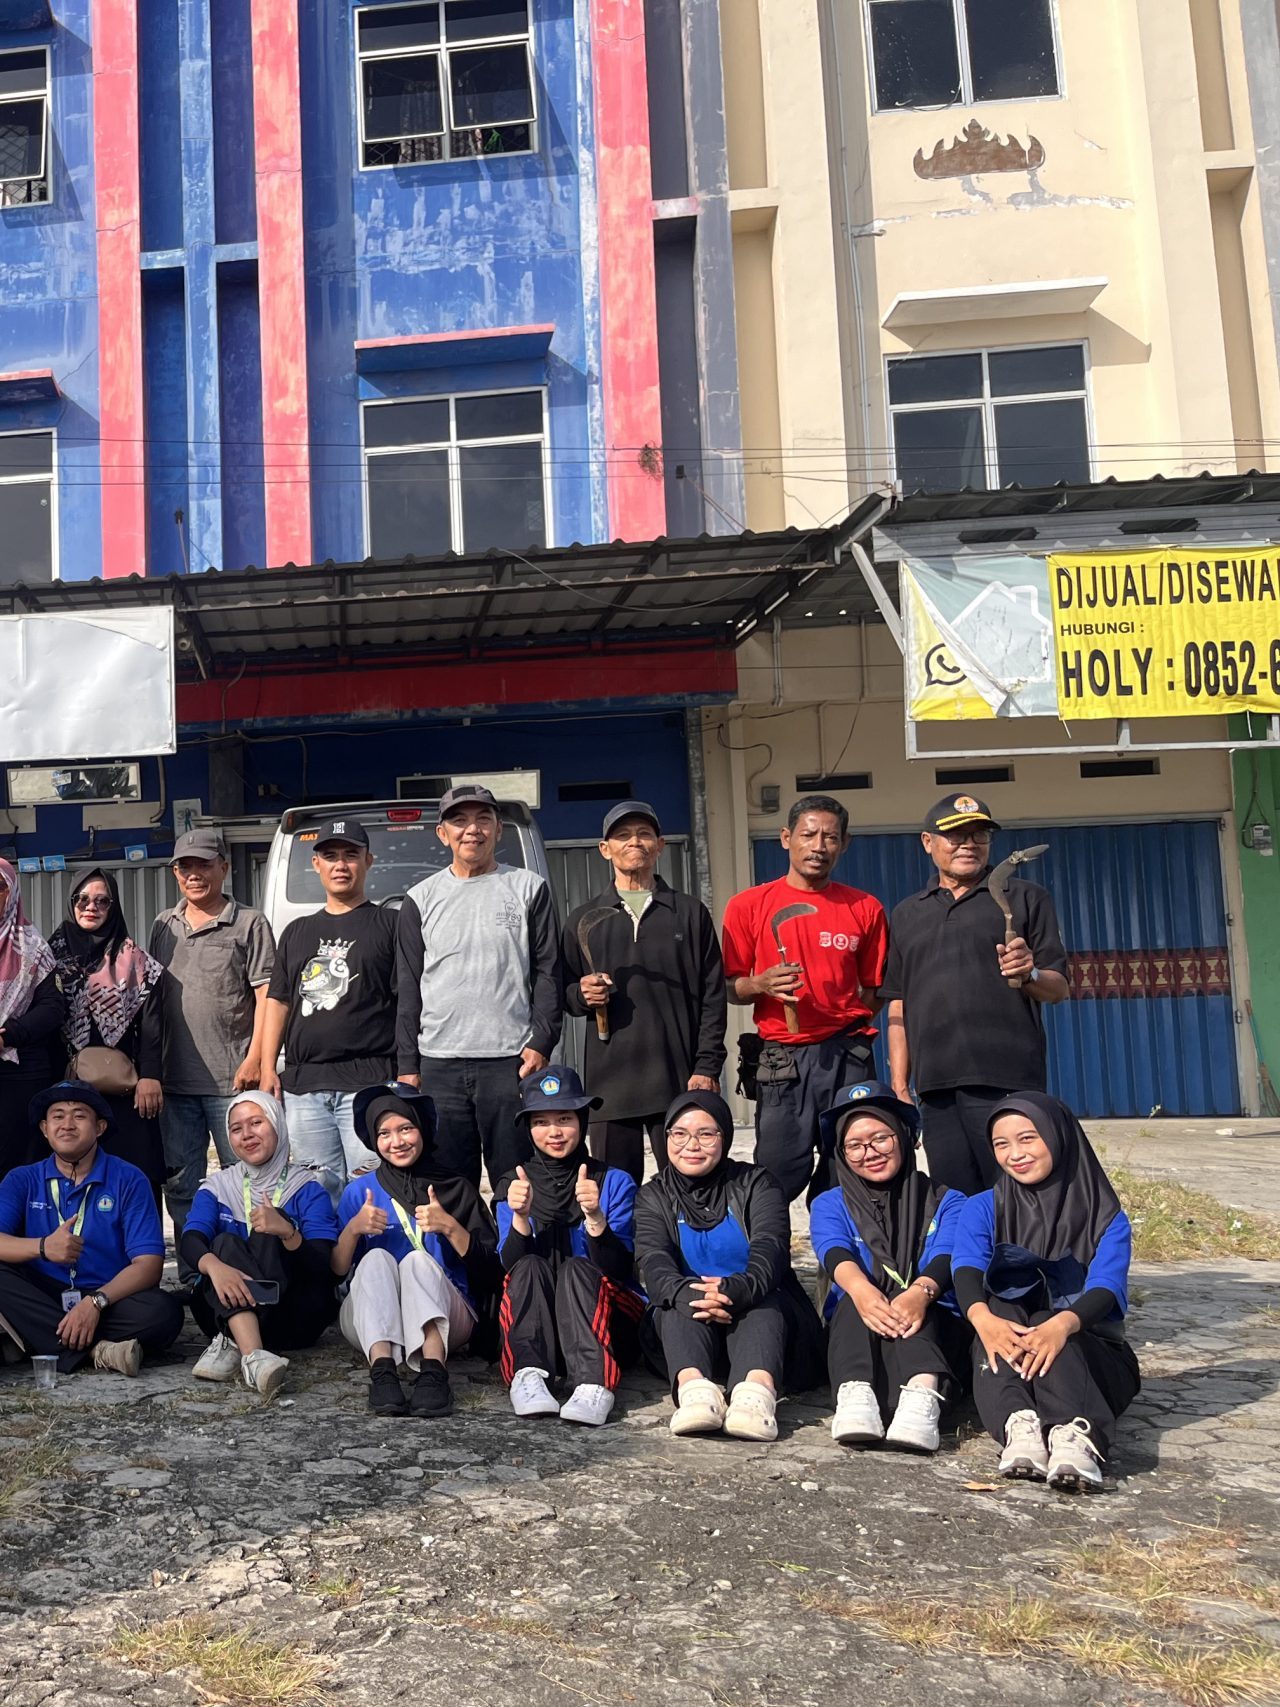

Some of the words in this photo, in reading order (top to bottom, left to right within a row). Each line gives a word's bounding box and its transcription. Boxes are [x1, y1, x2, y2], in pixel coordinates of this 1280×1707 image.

[1056, 559, 1280, 609] DIJUAL/DISEWA
[1060, 621, 1135, 637] HUBUNGI
[1061, 647, 1153, 698] HOLY
